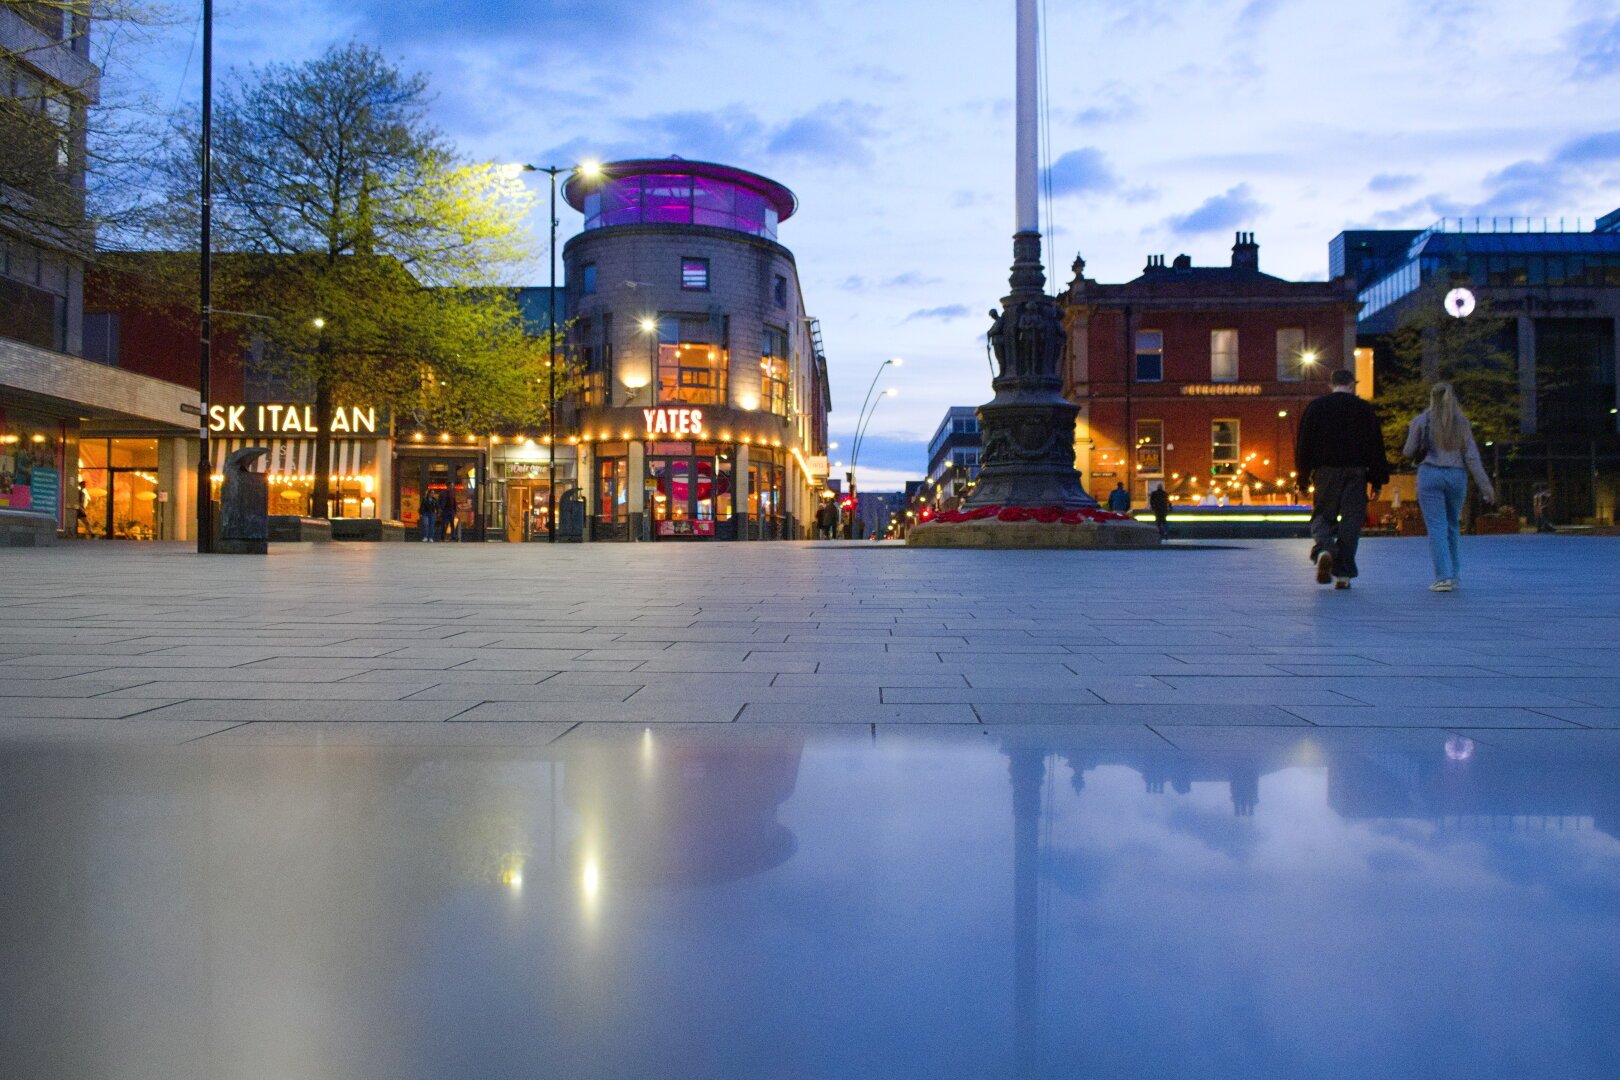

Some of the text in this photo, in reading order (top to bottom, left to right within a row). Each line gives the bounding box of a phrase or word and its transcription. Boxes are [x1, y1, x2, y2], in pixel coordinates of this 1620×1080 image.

[209, 405, 376, 433] SK ITALAN
[643, 409, 703, 434] YATES
